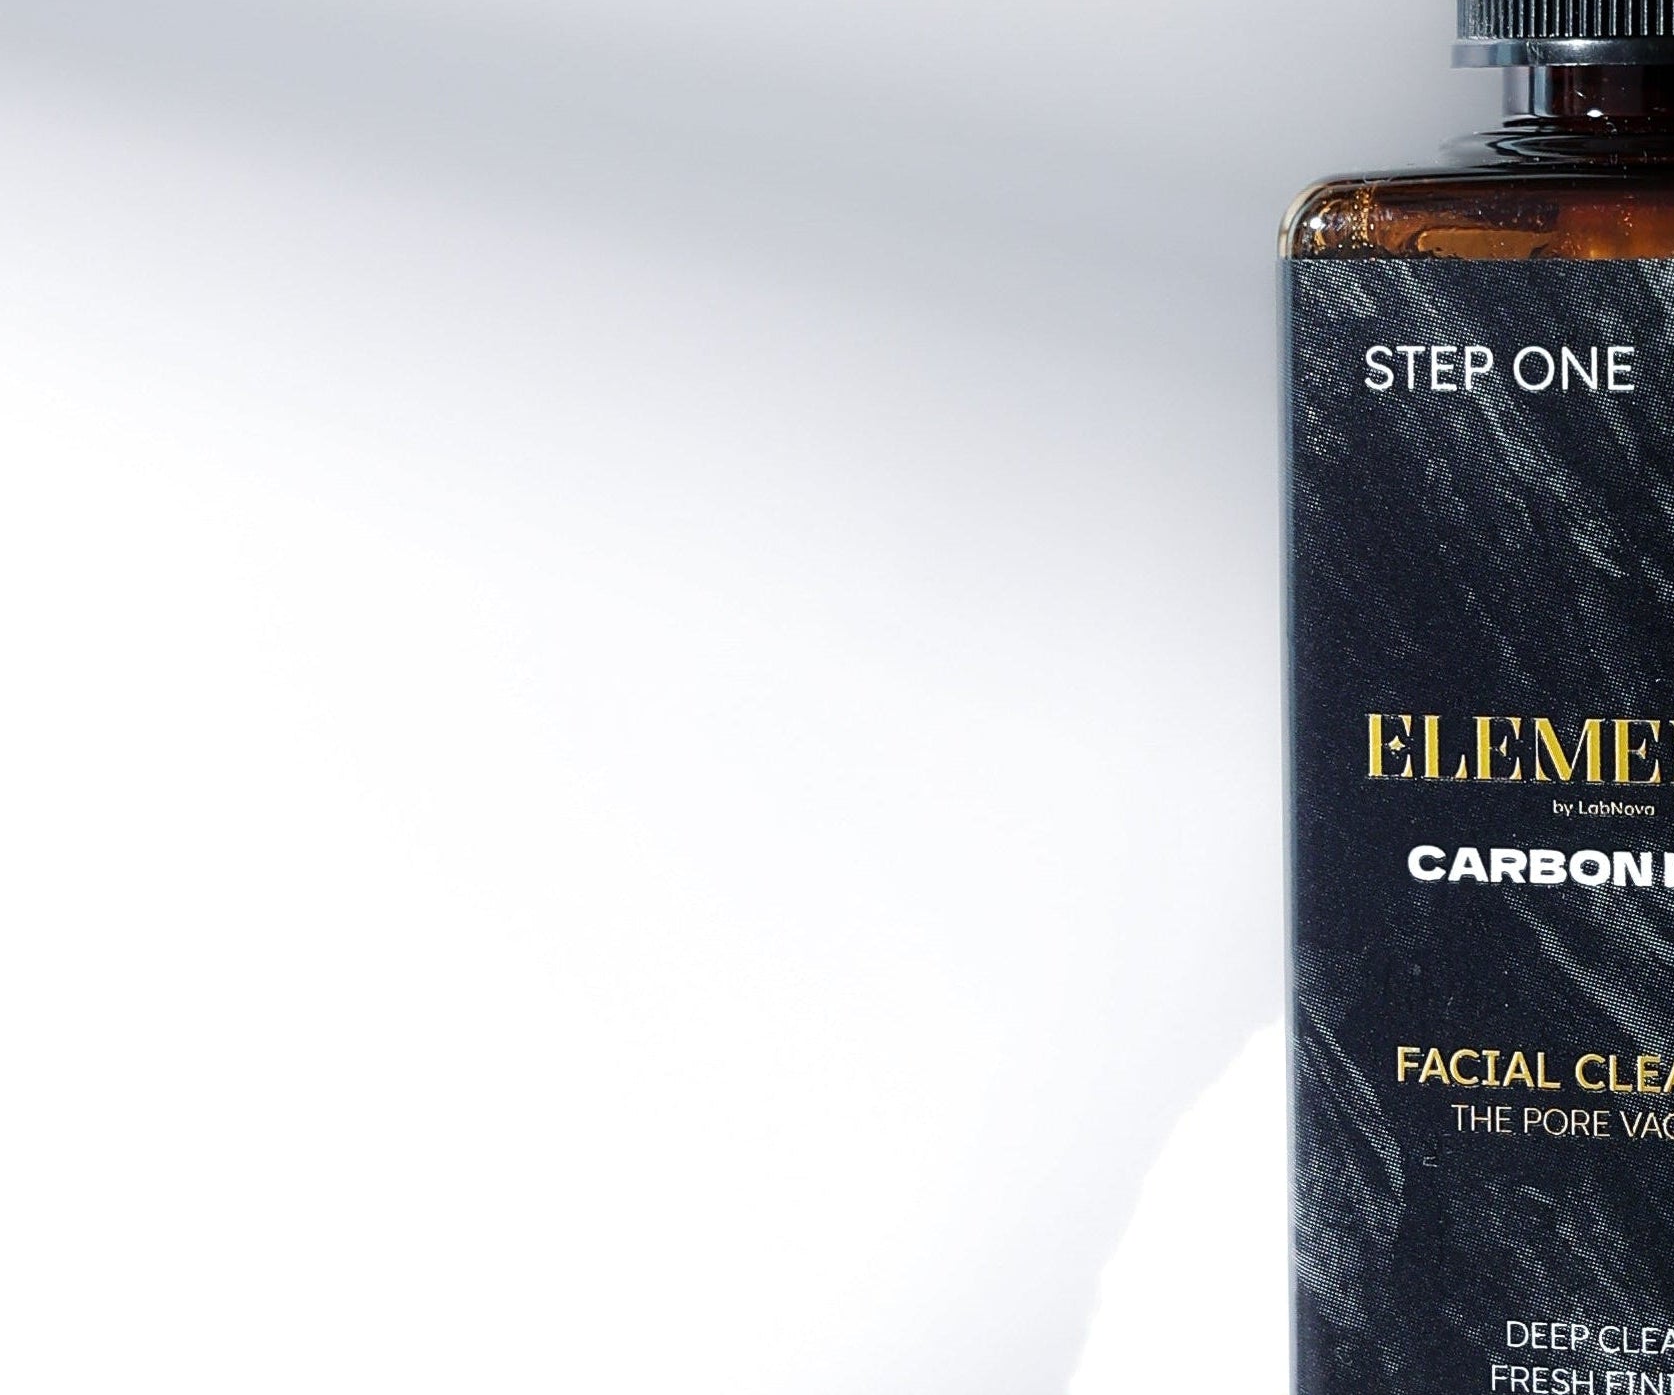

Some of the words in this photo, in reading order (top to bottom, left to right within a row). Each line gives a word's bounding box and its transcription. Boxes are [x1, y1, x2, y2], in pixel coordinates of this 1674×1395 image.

[1364, 345, 1494, 391] STEP
[1512, 345, 1635, 392] ONE
[1552, 800, 1573, 817] by
[1579, 800, 1655, 817] LabNova
[1408, 845, 1655, 886] CARBON
[1396, 1046, 1561, 1089] FACIAL
[1451, 1104, 1513, 1135] THE
[1523, 1107, 1611, 1139] PORE
[1506, 1320, 1589, 1352] DEEP
[1490, 1365, 1594, 1395] FRESH
